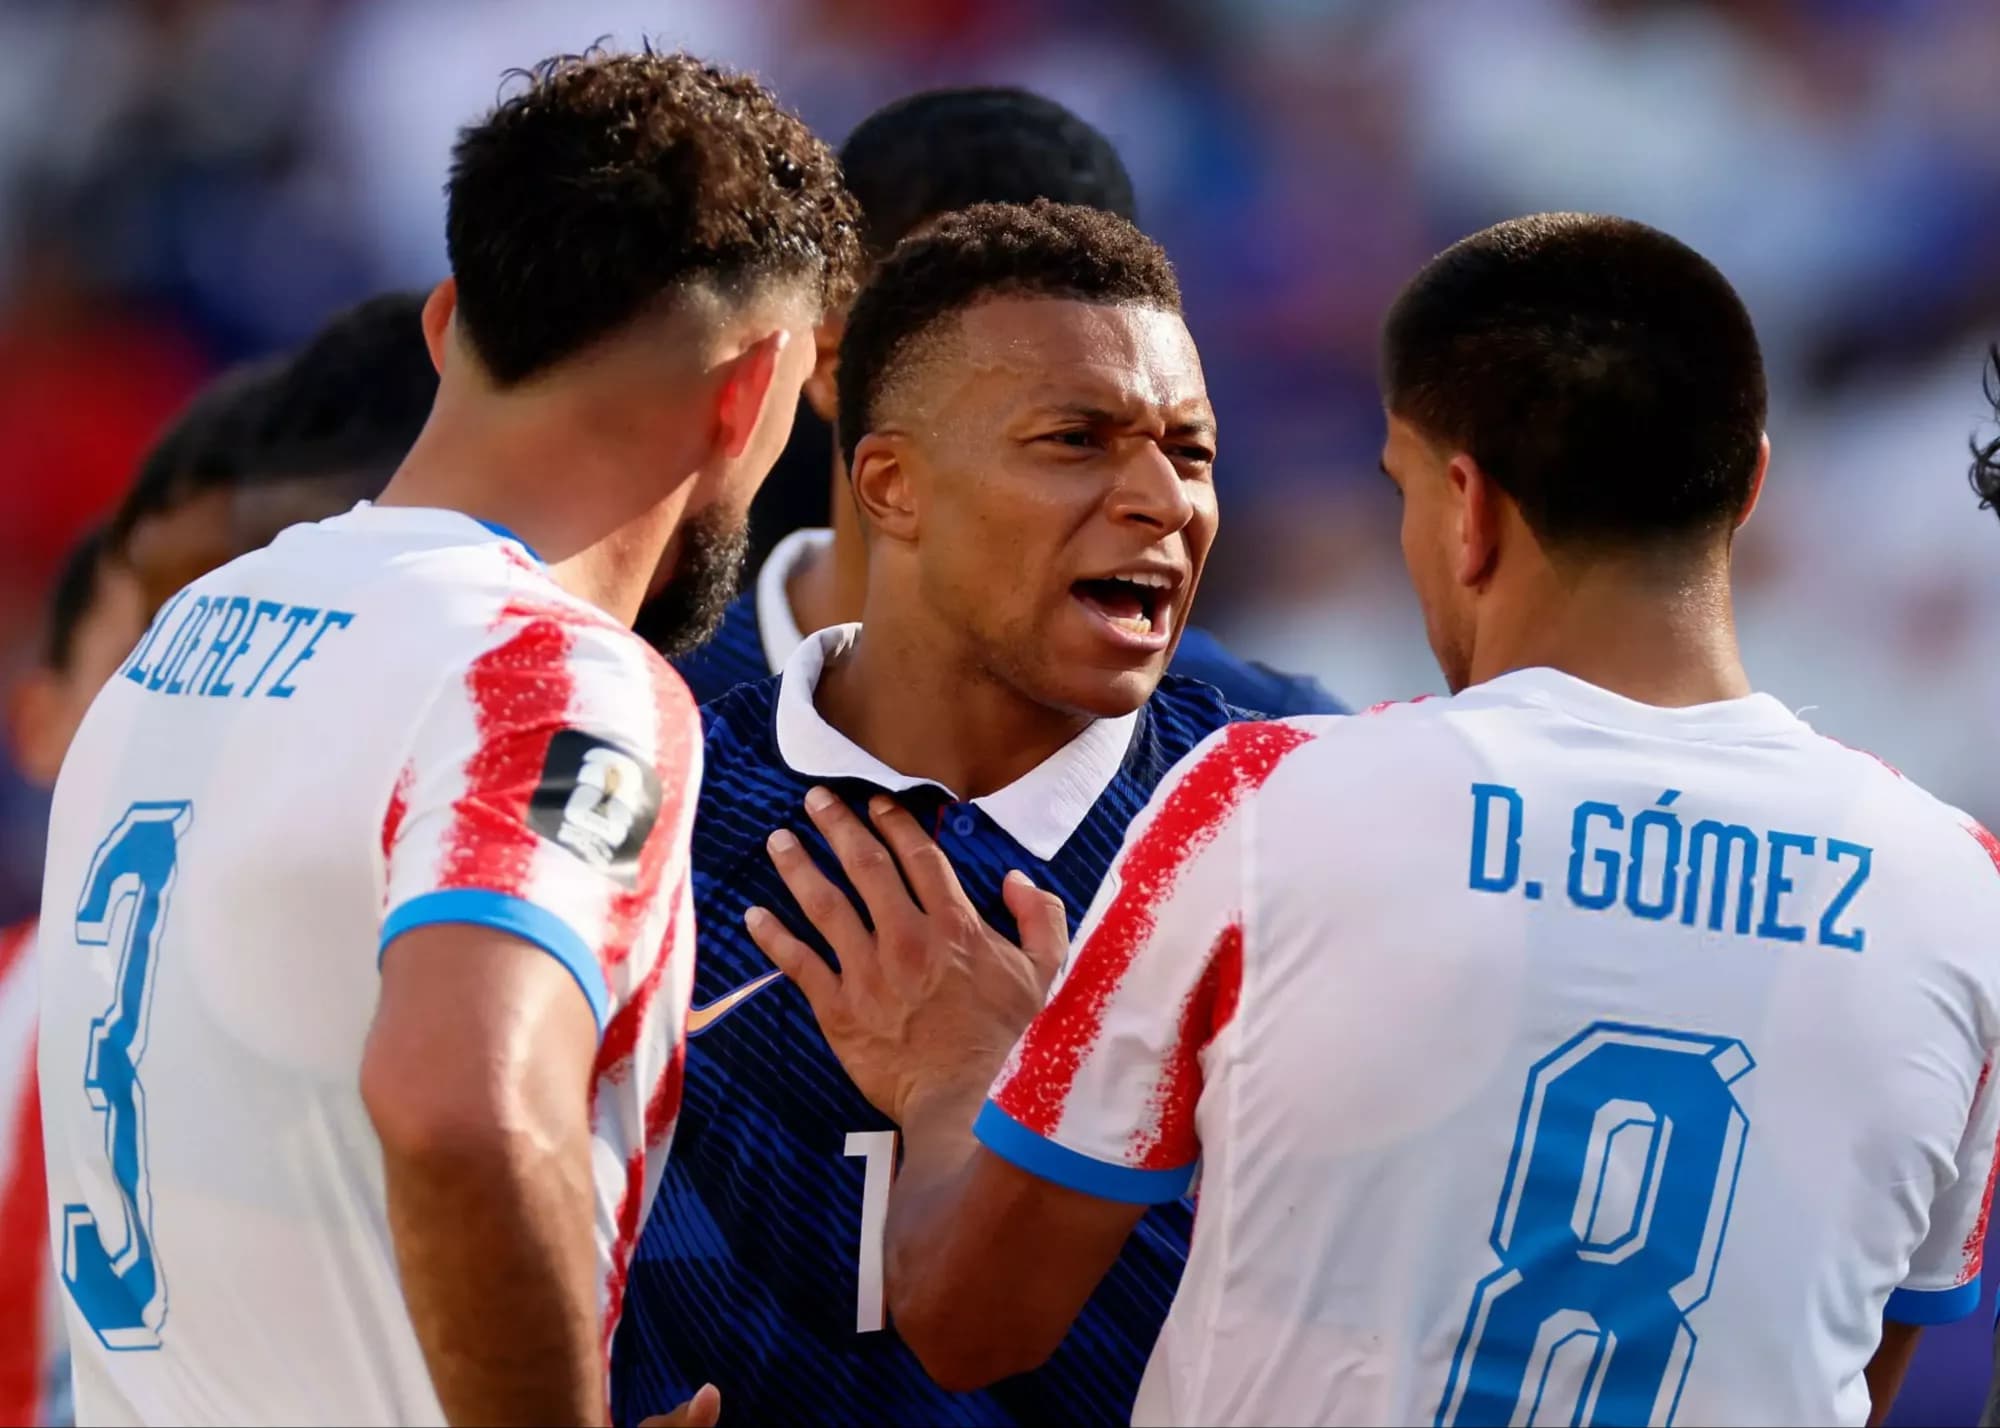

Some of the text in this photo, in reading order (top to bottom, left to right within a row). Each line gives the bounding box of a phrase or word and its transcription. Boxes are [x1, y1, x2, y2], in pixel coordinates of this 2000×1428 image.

[119, 589, 355, 698] LDERETE
[1469, 783, 1874, 953] D. GÓMEZ
[62, 799, 193, 1350] 3
[1433, 1020, 1757, 1428] 8
